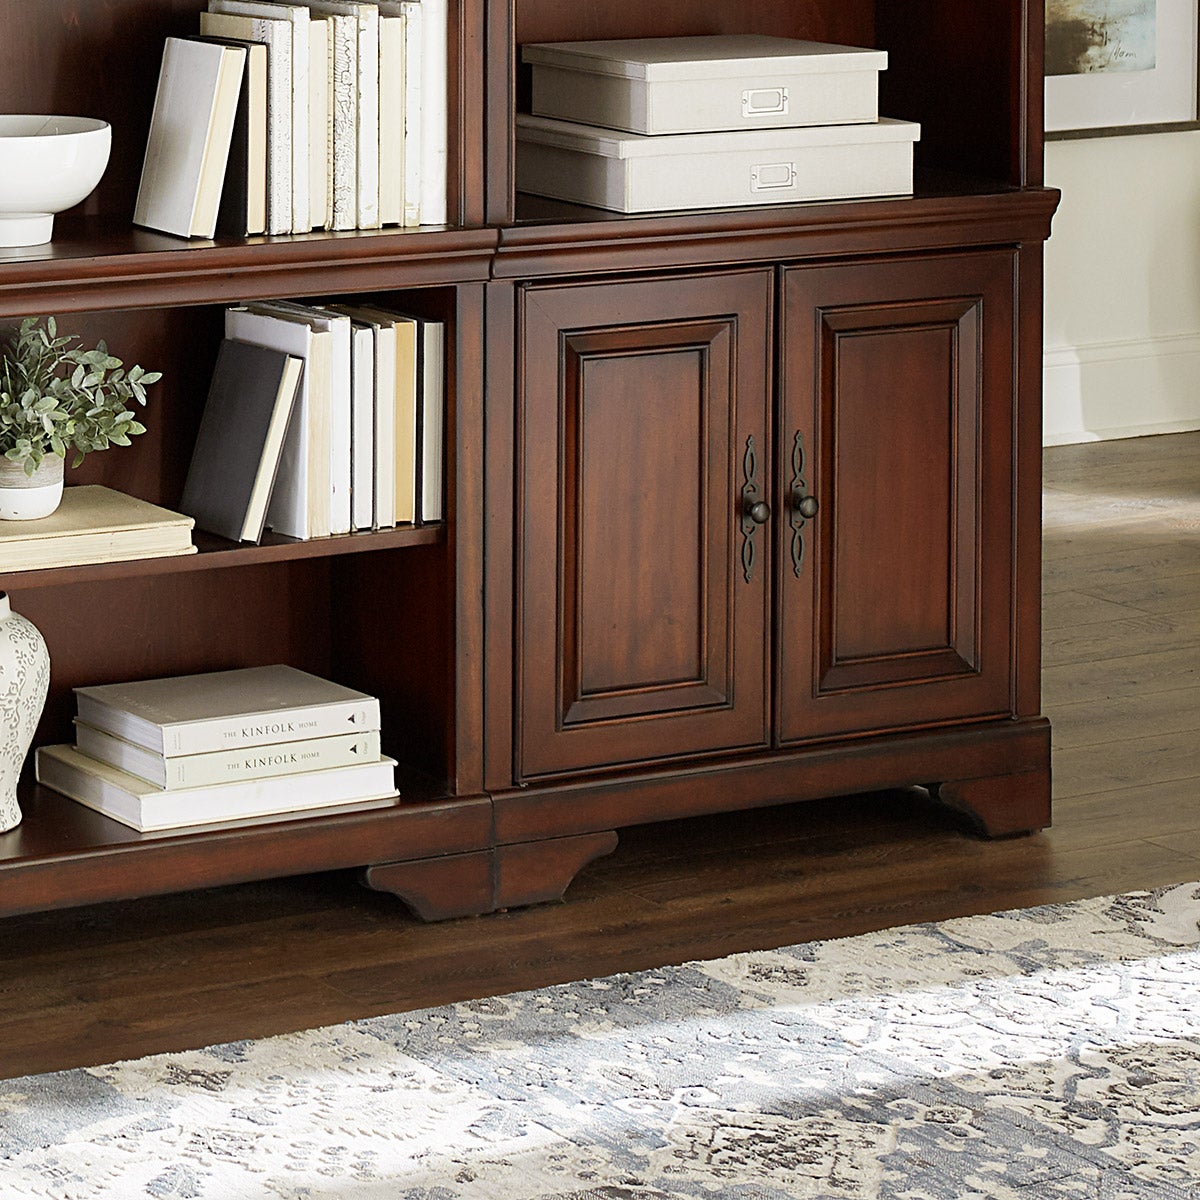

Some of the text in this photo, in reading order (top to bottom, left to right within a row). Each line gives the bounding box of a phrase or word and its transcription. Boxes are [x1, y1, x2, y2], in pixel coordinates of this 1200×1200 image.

[223, 721, 318, 739] THE KINFOLK HOME
[227, 752, 320, 770] THE KINFOLK HOME
